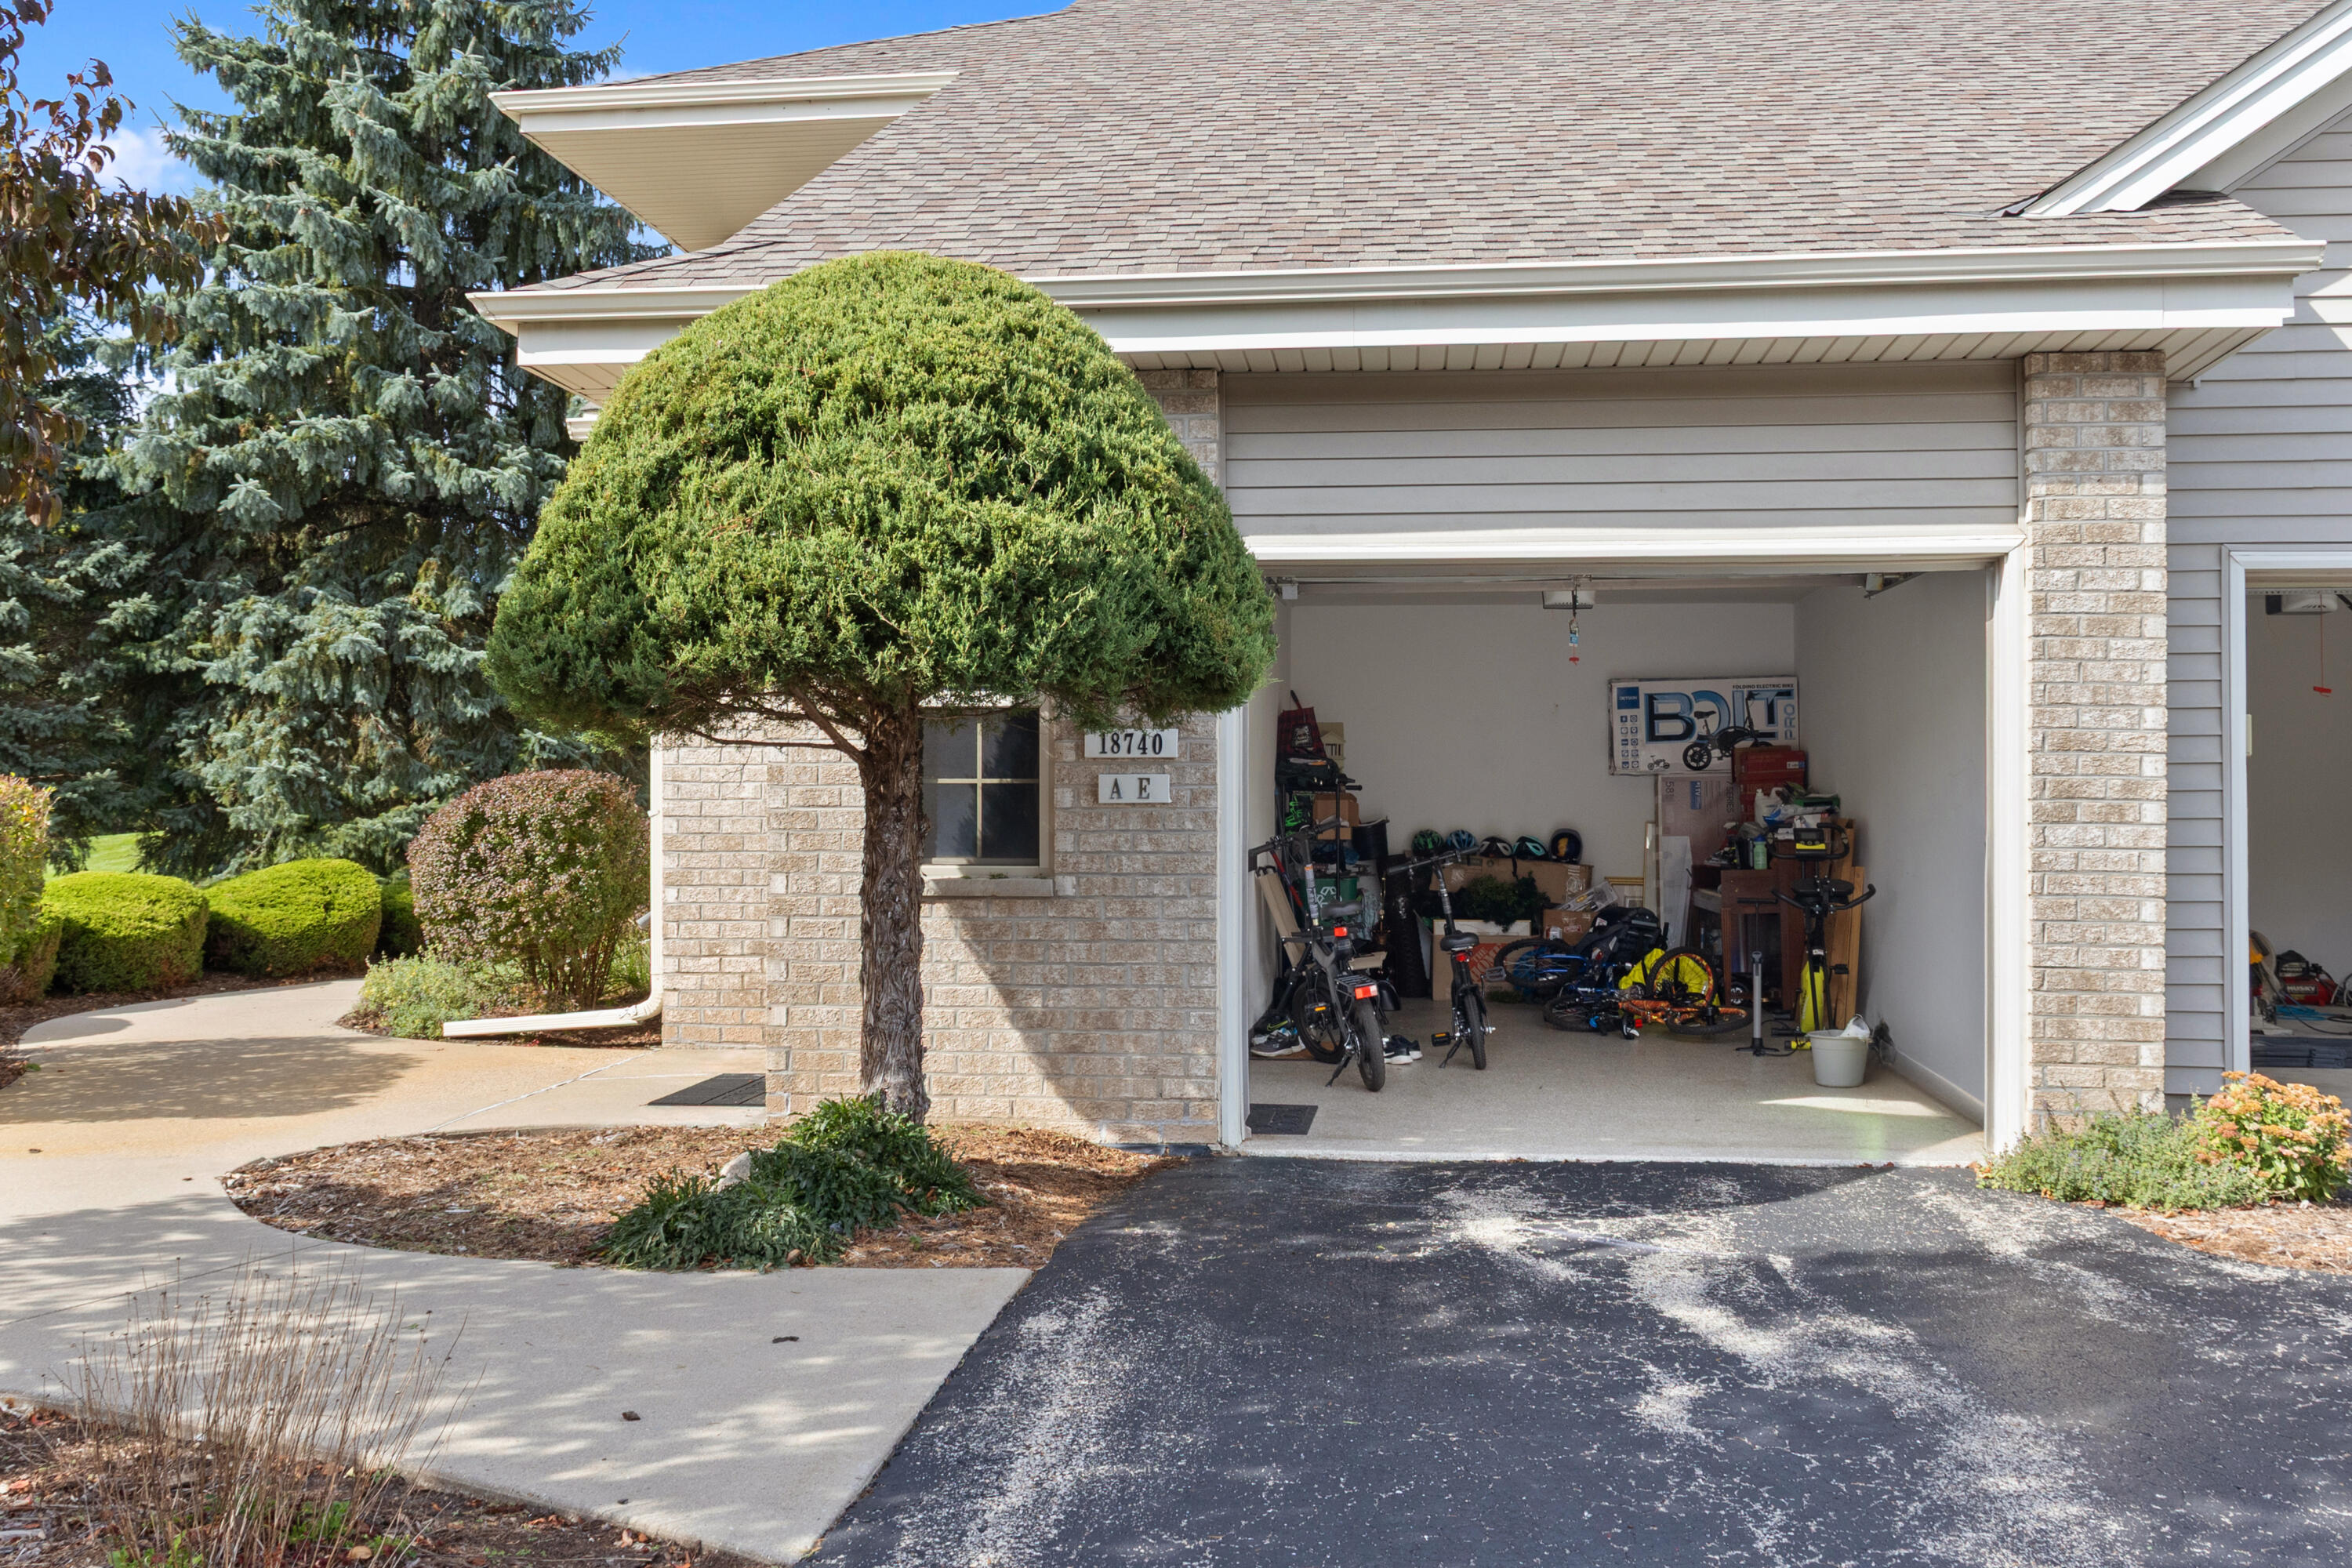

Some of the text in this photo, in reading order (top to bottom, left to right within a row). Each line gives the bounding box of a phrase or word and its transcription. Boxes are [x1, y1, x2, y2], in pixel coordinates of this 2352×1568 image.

[1784, 703, 1795, 740] PRO
[1099, 732, 1163, 755] 18740
[1110, 777, 1151, 800] A E
